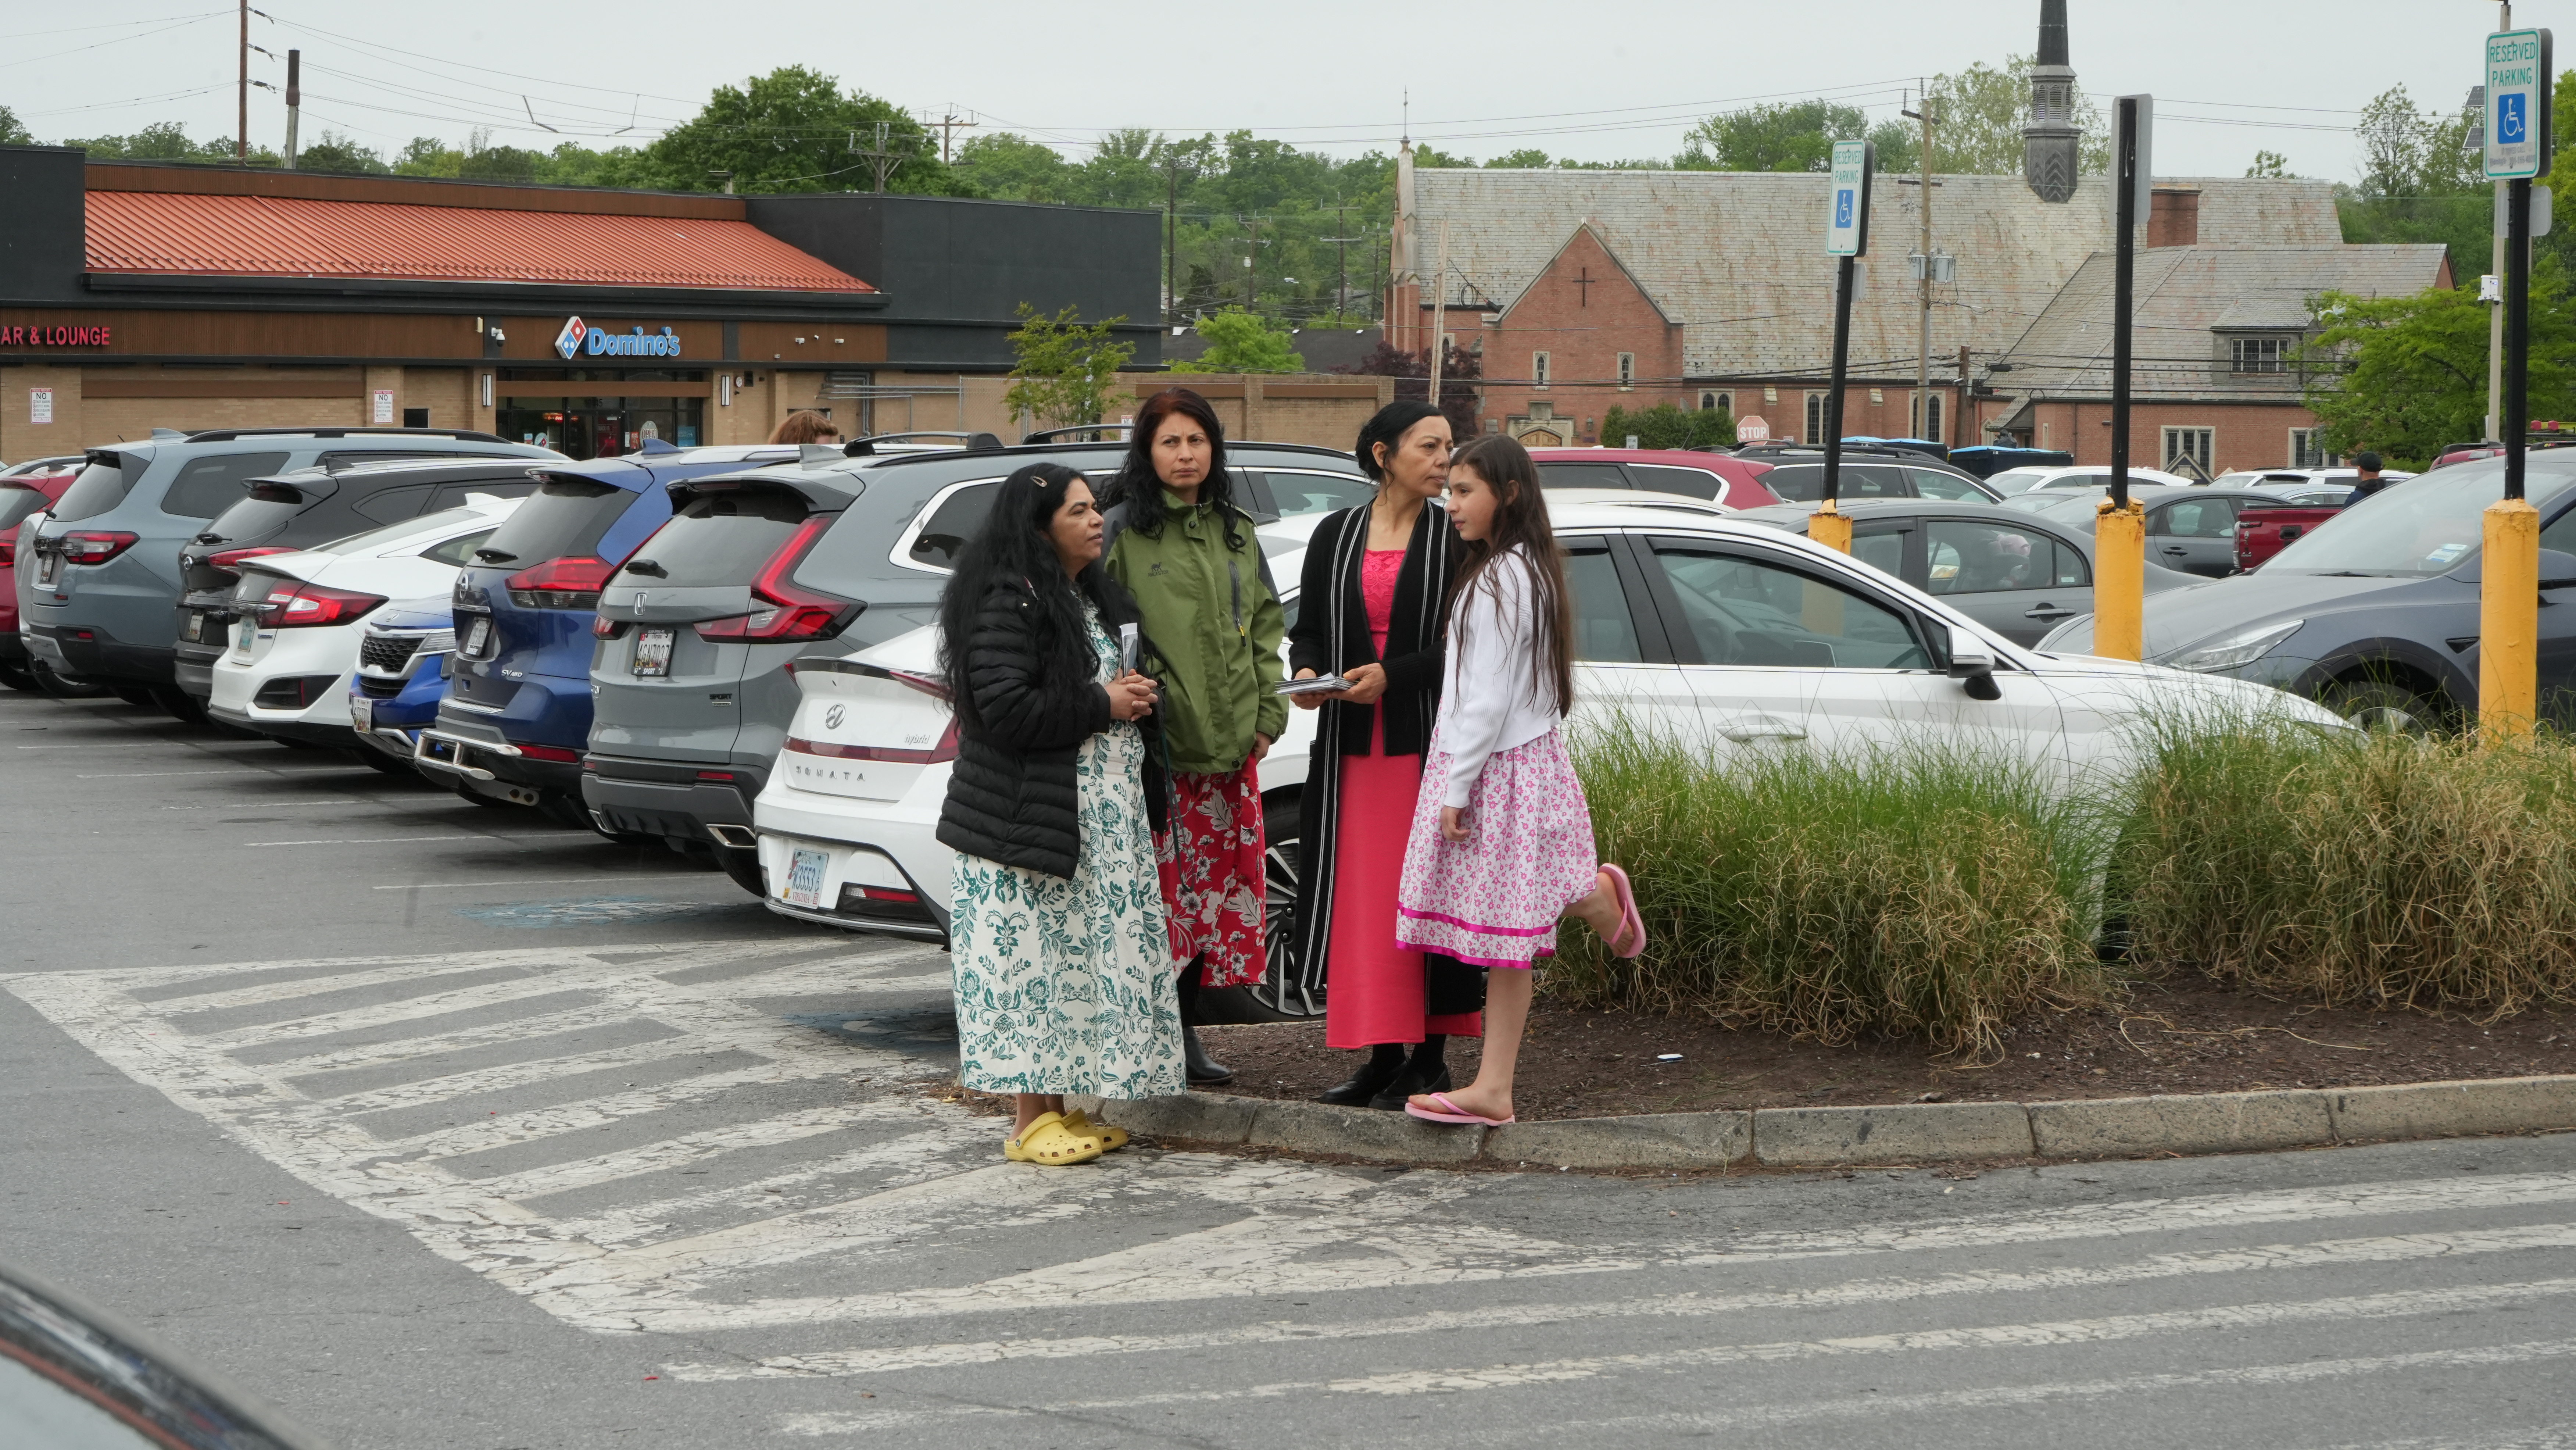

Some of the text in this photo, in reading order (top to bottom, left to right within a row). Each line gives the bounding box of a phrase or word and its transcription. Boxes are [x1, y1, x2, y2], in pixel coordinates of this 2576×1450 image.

[2490, 42, 2536, 63] RESERVED
[2492, 67, 2532, 87] PARKING
[1835, 151, 1861, 164] RESERVED
[1835, 170, 1858, 183] PARKING
[0, 326, 110, 345] AR & LOUNGE
[585, 326, 680, 356] Domino's
[642, 428, 657, 439] OPEN
[1740, 427, 1767, 439] STOP
[904, 734, 930, 745] hybrid
[796, 765, 865, 781] SONATA
[793, 892, 810, 904] VIRGINIA
